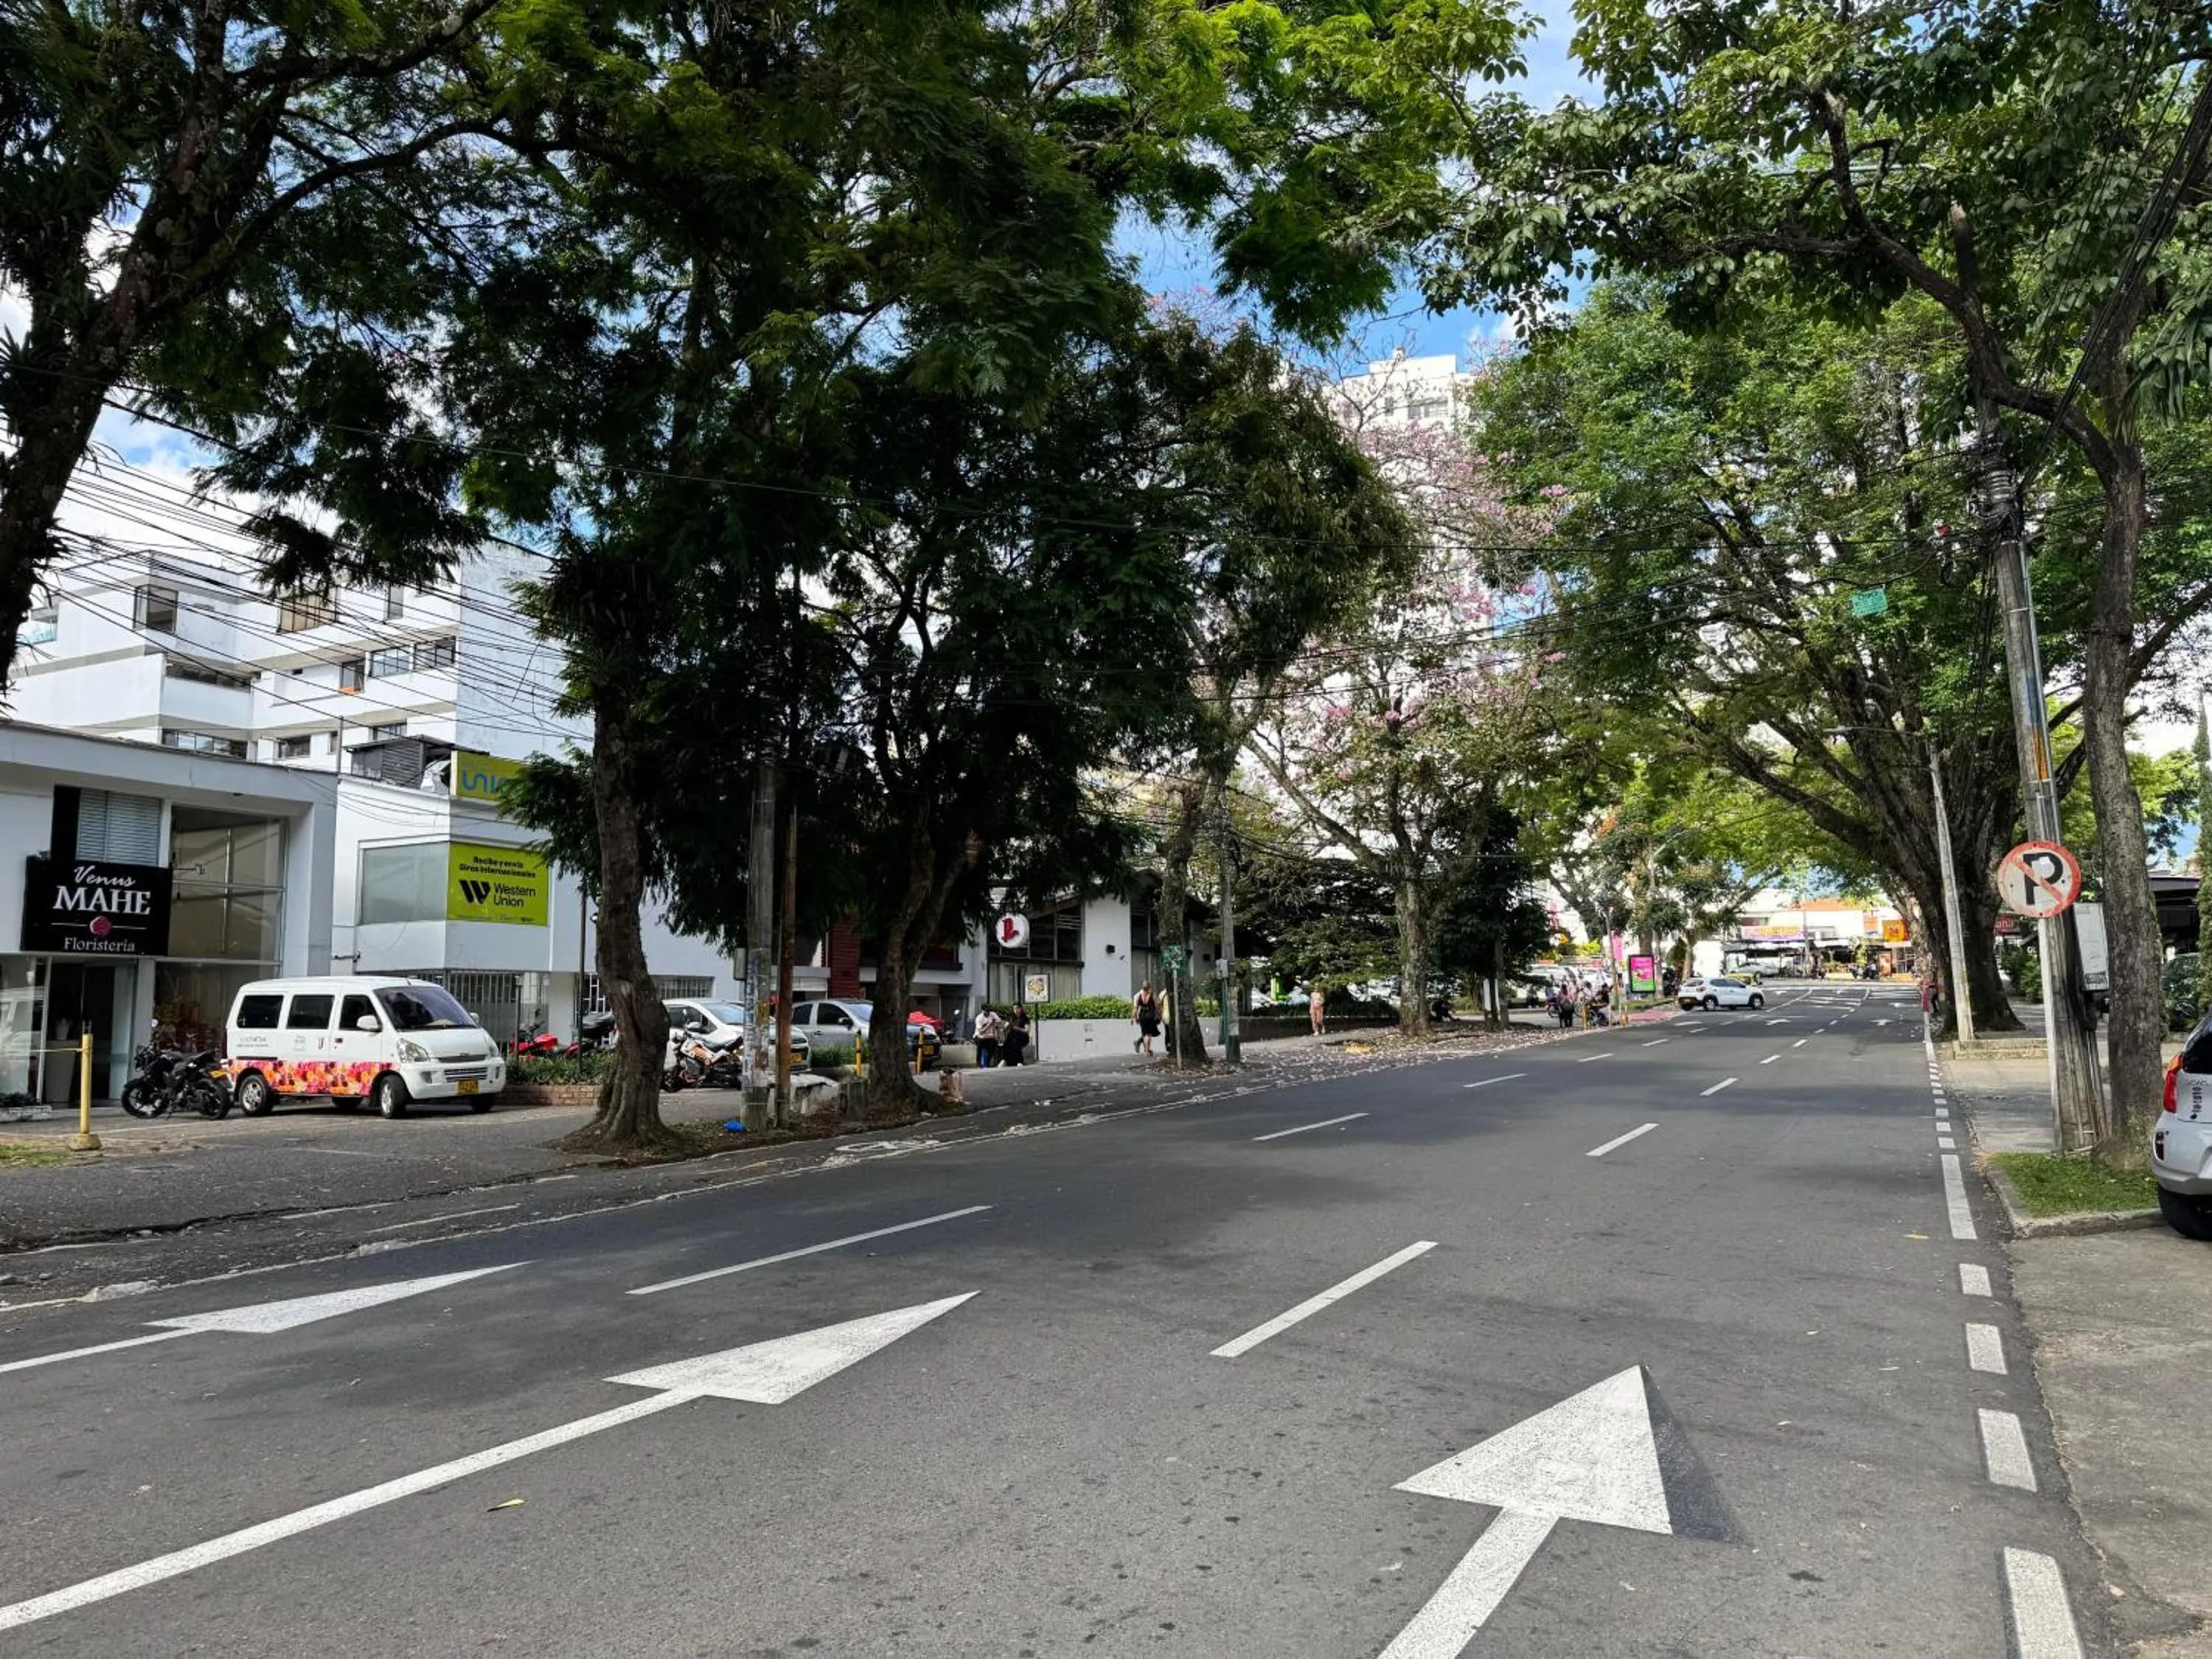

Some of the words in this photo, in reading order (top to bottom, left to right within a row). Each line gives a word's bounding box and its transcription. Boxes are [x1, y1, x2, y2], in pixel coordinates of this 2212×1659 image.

[74, 865, 136, 887] Venus
[2023, 852, 2064, 905] P
[53, 886, 151, 915] MAHE
[493, 882, 537, 897] Western
[493, 895, 525, 908] Union
